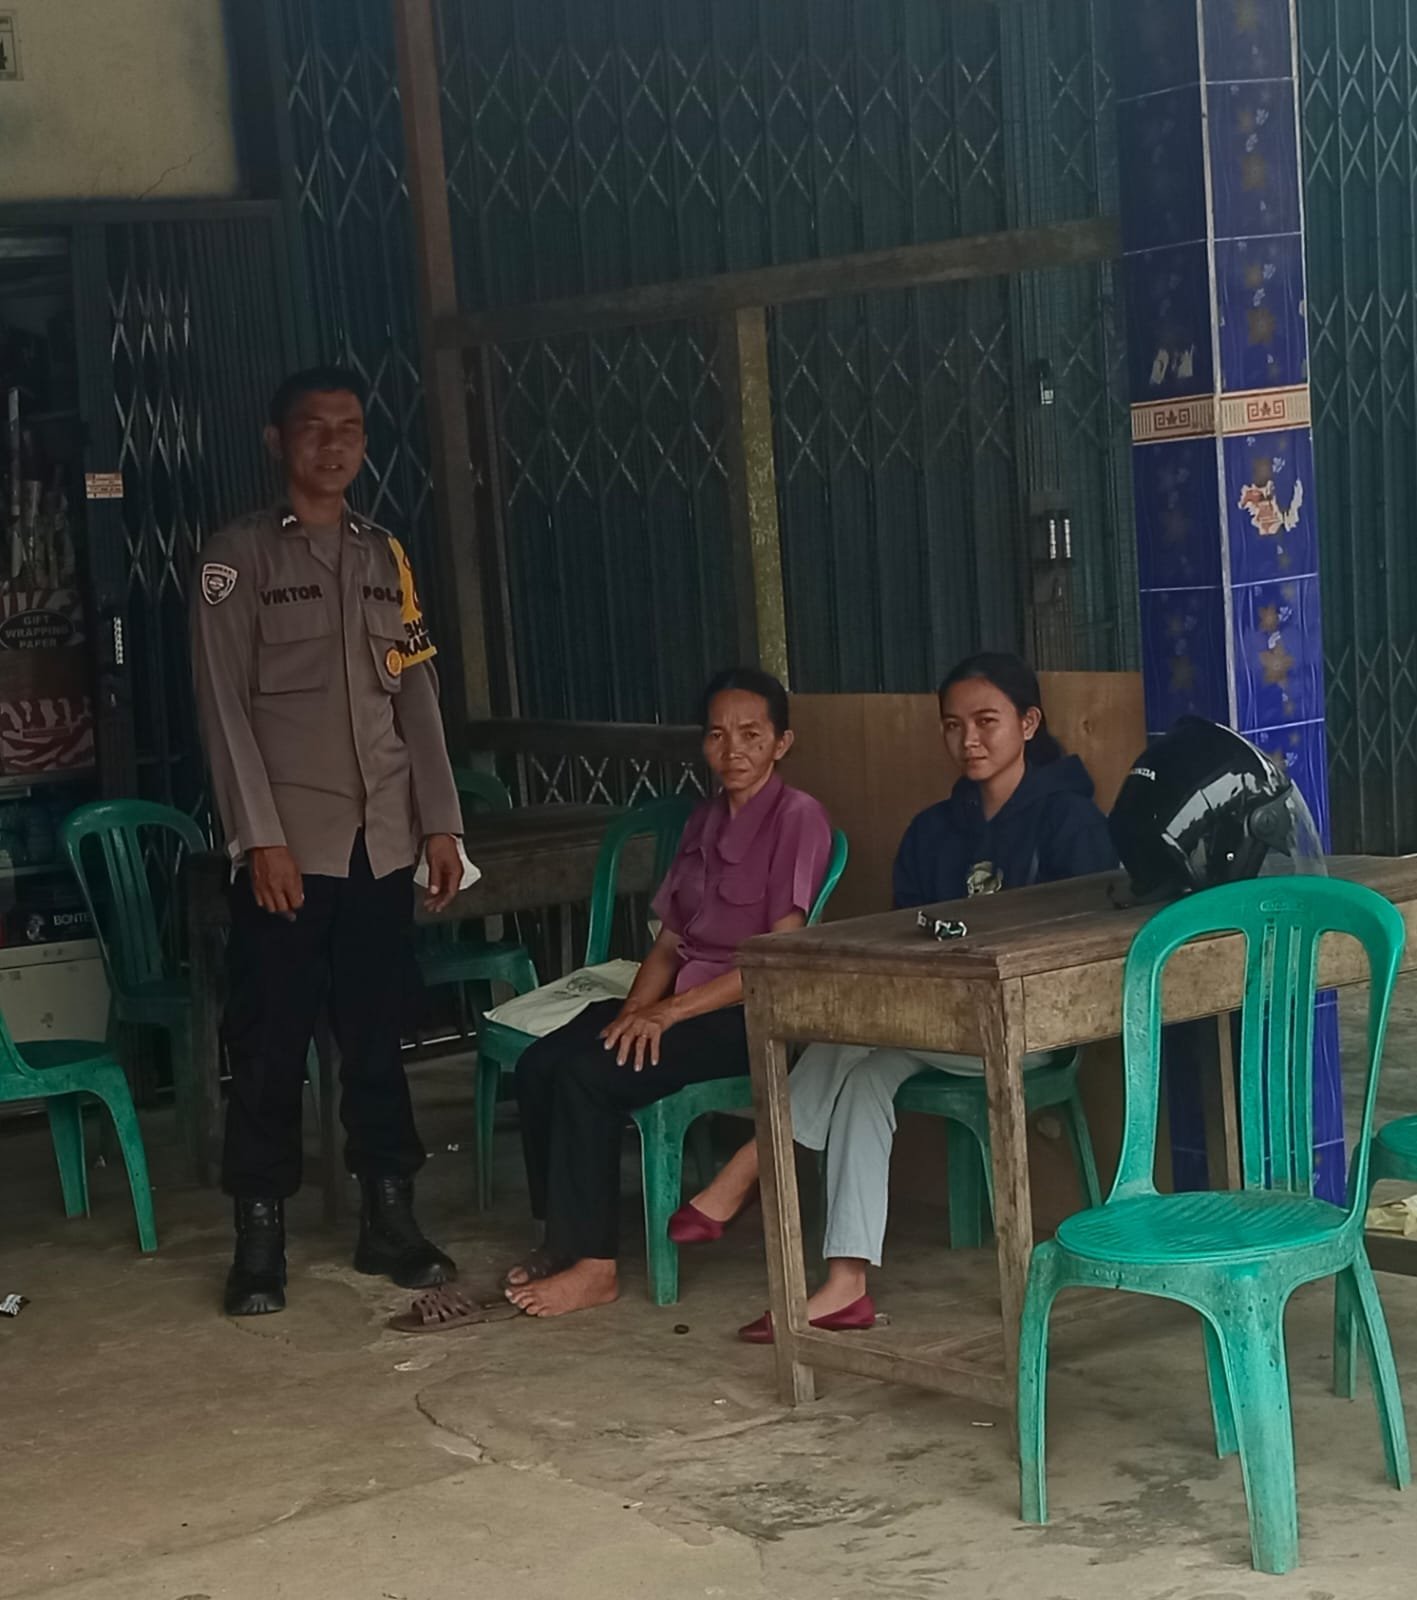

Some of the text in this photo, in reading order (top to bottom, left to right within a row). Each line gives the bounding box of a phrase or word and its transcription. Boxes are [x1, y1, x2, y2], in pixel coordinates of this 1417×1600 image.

[259, 584, 323, 606] VIKTOR
[23, 615, 49, 625] GIFT
[4, 624, 70, 639] WRAPPING
[18, 637, 57, 649] PAPER
